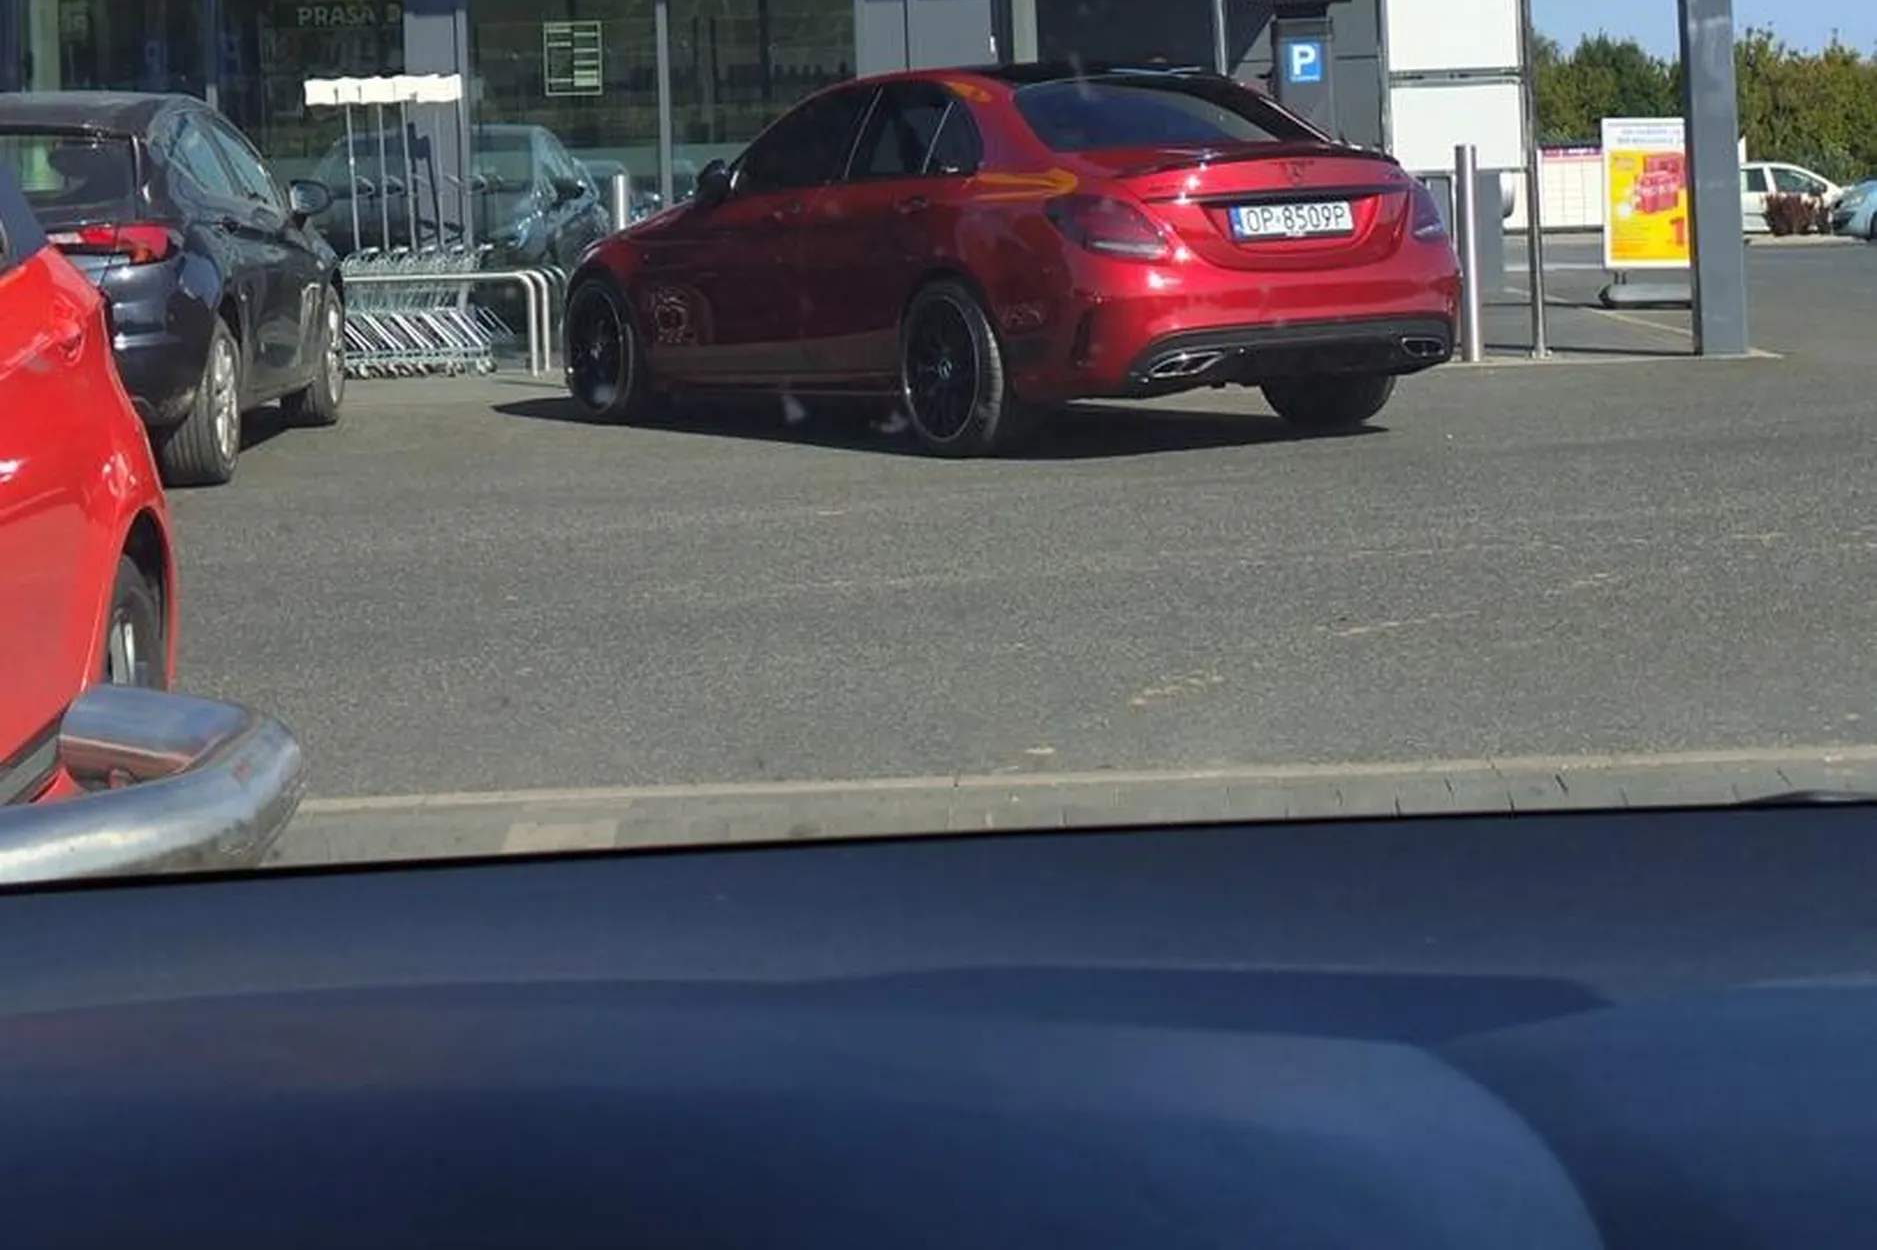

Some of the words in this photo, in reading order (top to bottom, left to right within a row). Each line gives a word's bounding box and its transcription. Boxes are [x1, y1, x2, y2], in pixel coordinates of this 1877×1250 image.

[1293, 44, 1316, 75] P
[1246, 208, 1274, 232] OP
[1283, 204, 1346, 230] 8509P
